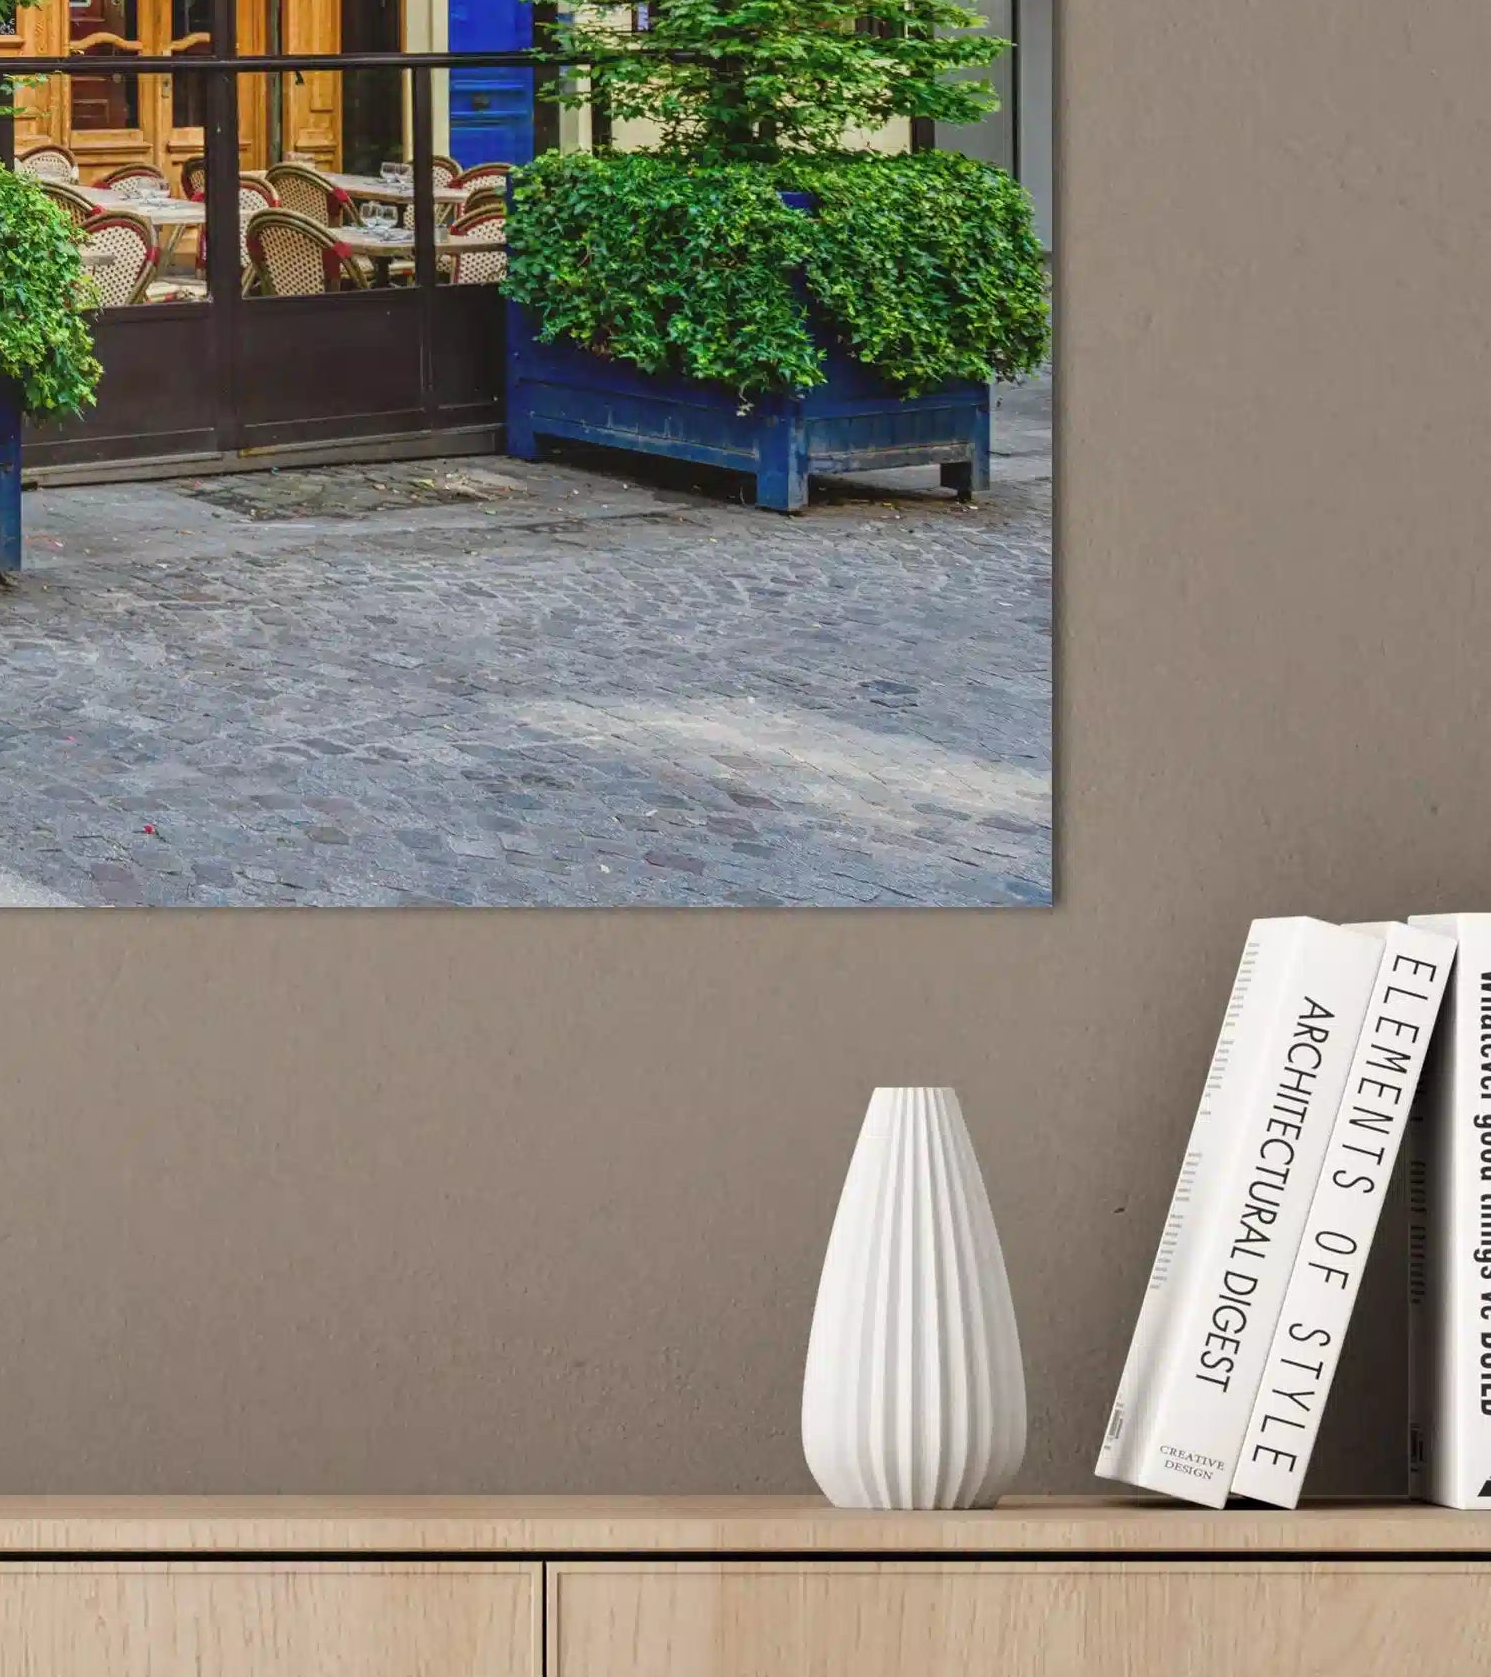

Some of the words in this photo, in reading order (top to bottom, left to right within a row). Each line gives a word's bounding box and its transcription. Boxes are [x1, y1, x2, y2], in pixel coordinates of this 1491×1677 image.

[1230, 995, 1336, 1260] ARCHITECTURAL
[1332, 953, 1438, 1195] ELEMENTS
[1308, 1230, 1359, 1291] OF
[1195, 1269, 1259, 1394] DIGEST
[1159, 1444, 1226, 1471] CREATIVE
[1252, 1322, 1332, 1473] STYLE
[1164, 1459, 1214, 1480] DESIGN
